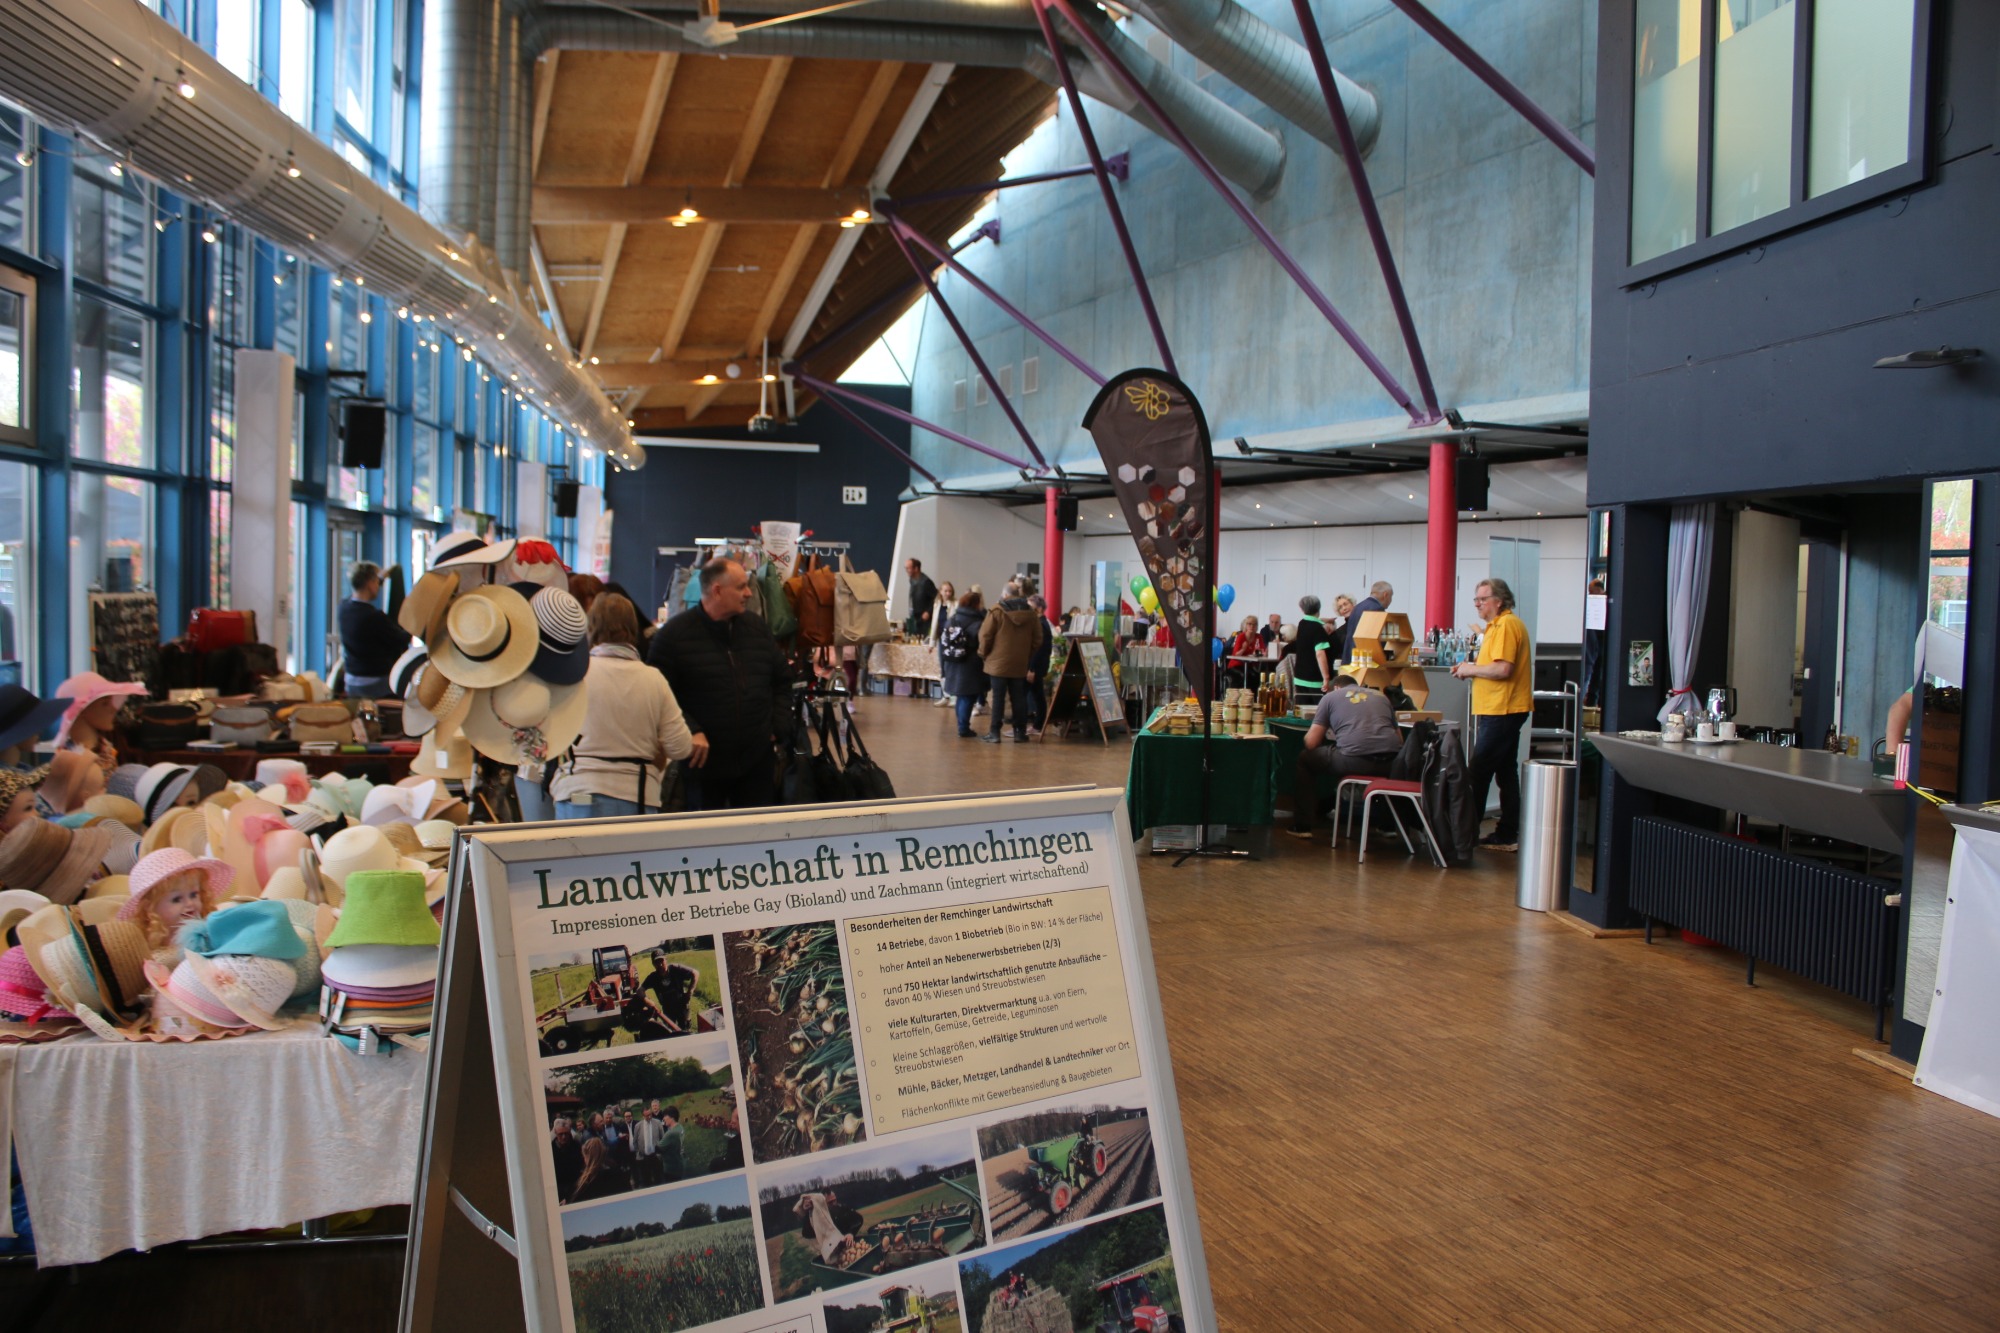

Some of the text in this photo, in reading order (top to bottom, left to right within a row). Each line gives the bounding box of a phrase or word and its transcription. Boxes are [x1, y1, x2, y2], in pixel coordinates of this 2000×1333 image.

[533, 828, 1093, 909] Landwirtschaft in Remchingen
[551, 860, 1089, 935] Impressionen der Betriebe Gay (Bioland) und Zachmann (integriert wirtschaftend)
[850, 898, 1053, 933] Besonderheiten der Remchinger Landwirtschaft
[877, 912, 1103, 952] 14 Betriebe, davon 1 Biobetrieb (Bio in BW: 14 % der Fläche)
[880, 938, 1060, 974] hoher Anteil an Nebenerwerbsbetrieben (2/3)
[883, 985, 902, 995] rund
[904, 982, 920, 992] 750
[922, 978, 949, 989] Hektar
[952, 964, 1022, 984] landwirtschaftlich
[1024, 960, 1056, 974] genutzte
[1058, 952, 1100, 967] Anbaufläche
[884, 973, 1046, 1007] davon 40 % Wiesen und Streuobstwiesen
[888, 987, 1087, 1028] viele Kulturarten, Direktvermarktung u.a. von Eiern,
[890, 1003, 1058, 1040] Kartoffeln, Gemüse, Getreide, Leguminosen
[892, 1014, 1108, 1062] kleine Schlaggrößen, vielfältige Strukturen und wertvolle
[894, 1054, 964, 1074] Streuobstwiesen
[898, 1041, 1130, 1096] Mühle, Bäcker, Metzger, Landhandel & Landtechniker vor Ort
[902, 1066, 1112, 1118] Flächenkonflikte mit Gewerbeansiedlung & Baugebieten
